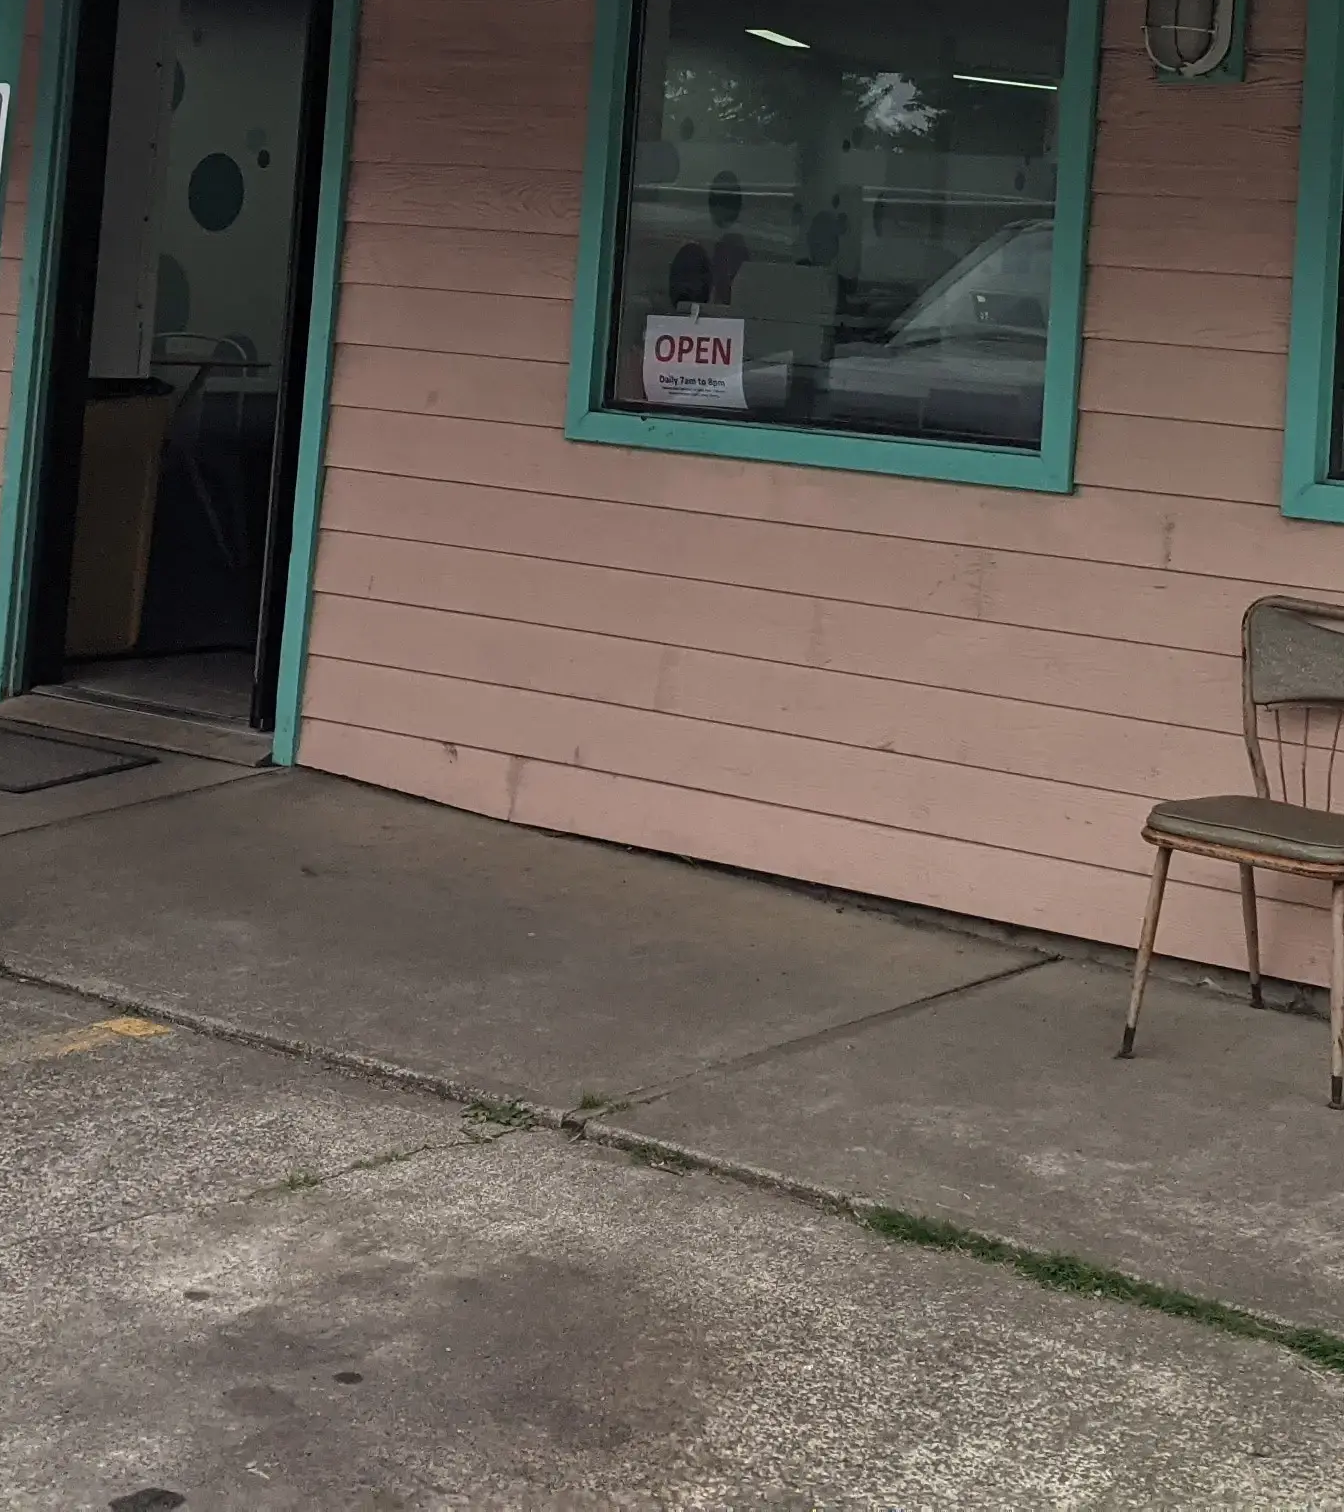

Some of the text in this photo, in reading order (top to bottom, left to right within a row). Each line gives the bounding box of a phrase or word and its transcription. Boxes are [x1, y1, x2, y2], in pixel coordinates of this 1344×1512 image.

[654, 334, 732, 366] OPEN
[659, 374, 726, 388] Daily 7am to 8pm
